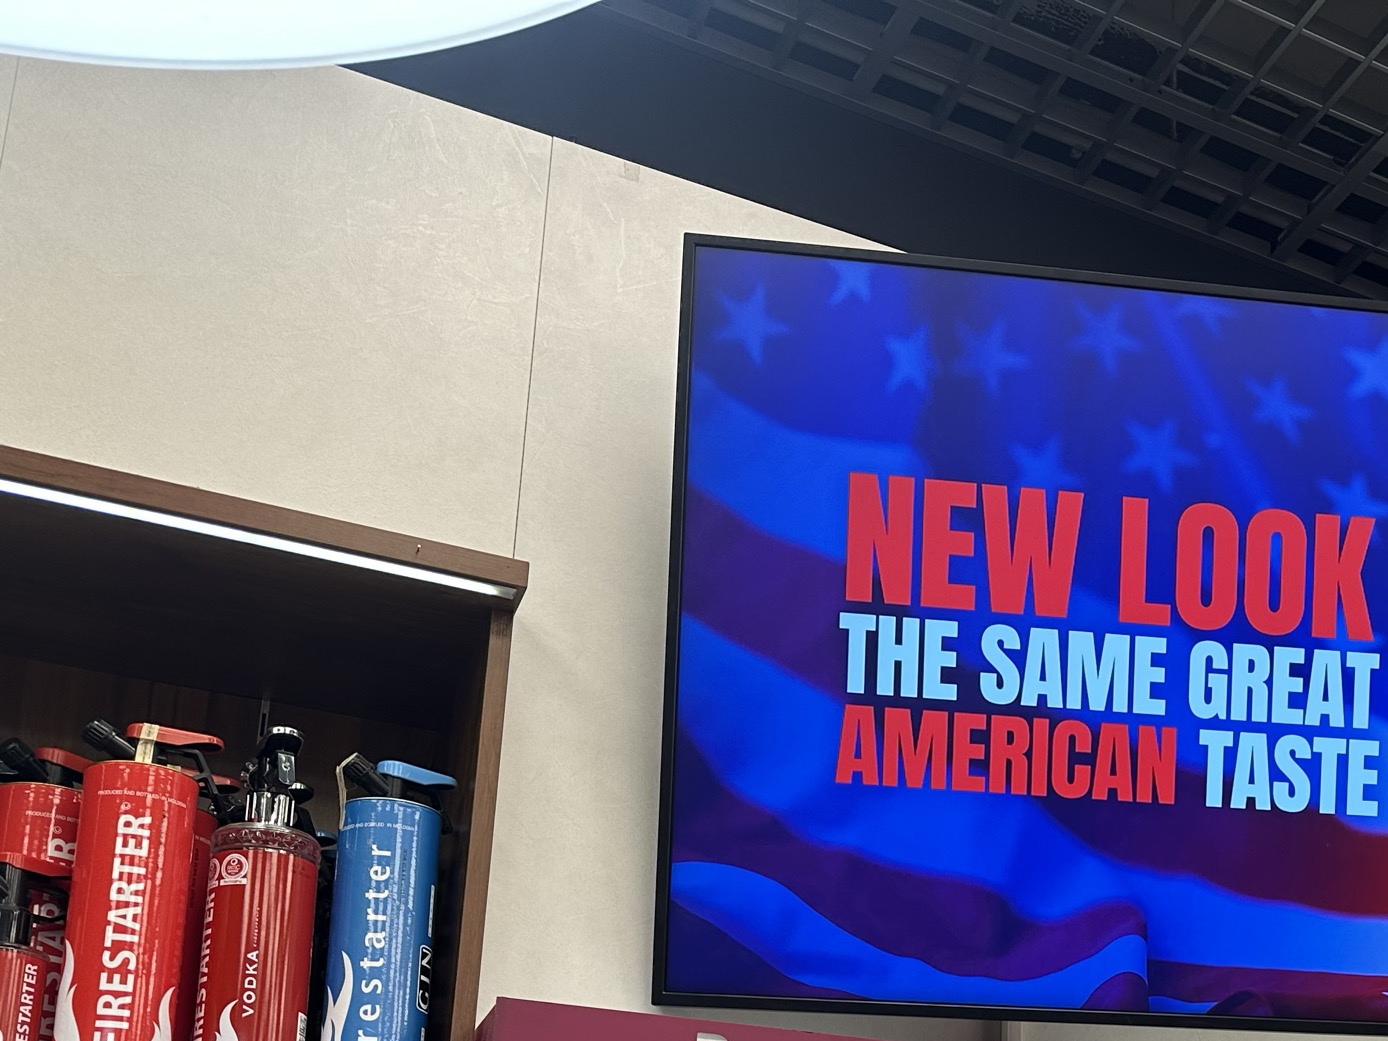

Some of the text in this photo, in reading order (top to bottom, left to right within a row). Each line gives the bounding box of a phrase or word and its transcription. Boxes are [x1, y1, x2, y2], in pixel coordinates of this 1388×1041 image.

[845, 471, 1376, 642] NEW LOOK
[839, 611, 1381, 729] THE SAME GREAT
[835, 704, 1380, 817] AMERICAN TASTE
[241, 950, 259, 1019] VODKA
[418, 947, 433, 1011] GIN
